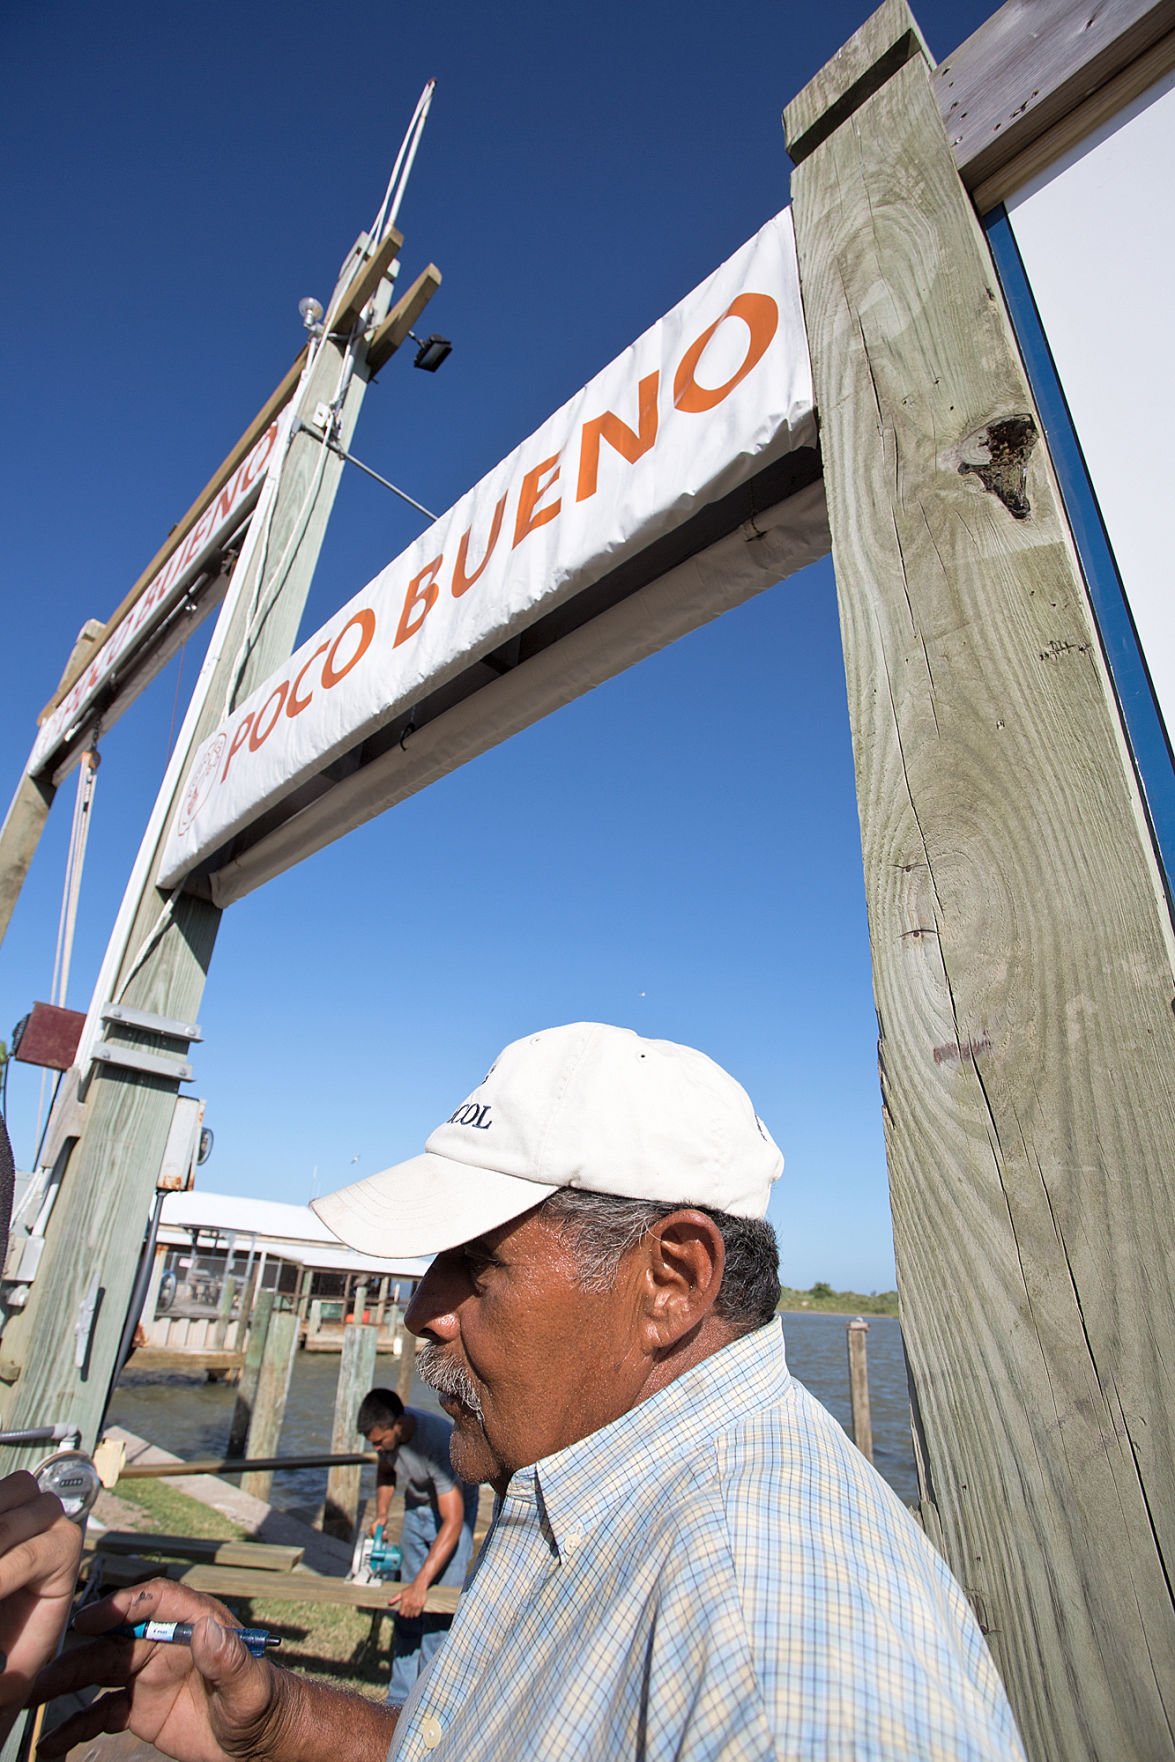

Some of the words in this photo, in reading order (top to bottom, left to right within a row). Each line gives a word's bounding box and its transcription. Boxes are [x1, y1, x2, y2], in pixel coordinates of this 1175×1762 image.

[133, 424, 278, 631] BUENO
[220, 607, 376, 784] POCO
[393, 292, 779, 648] BUENO
